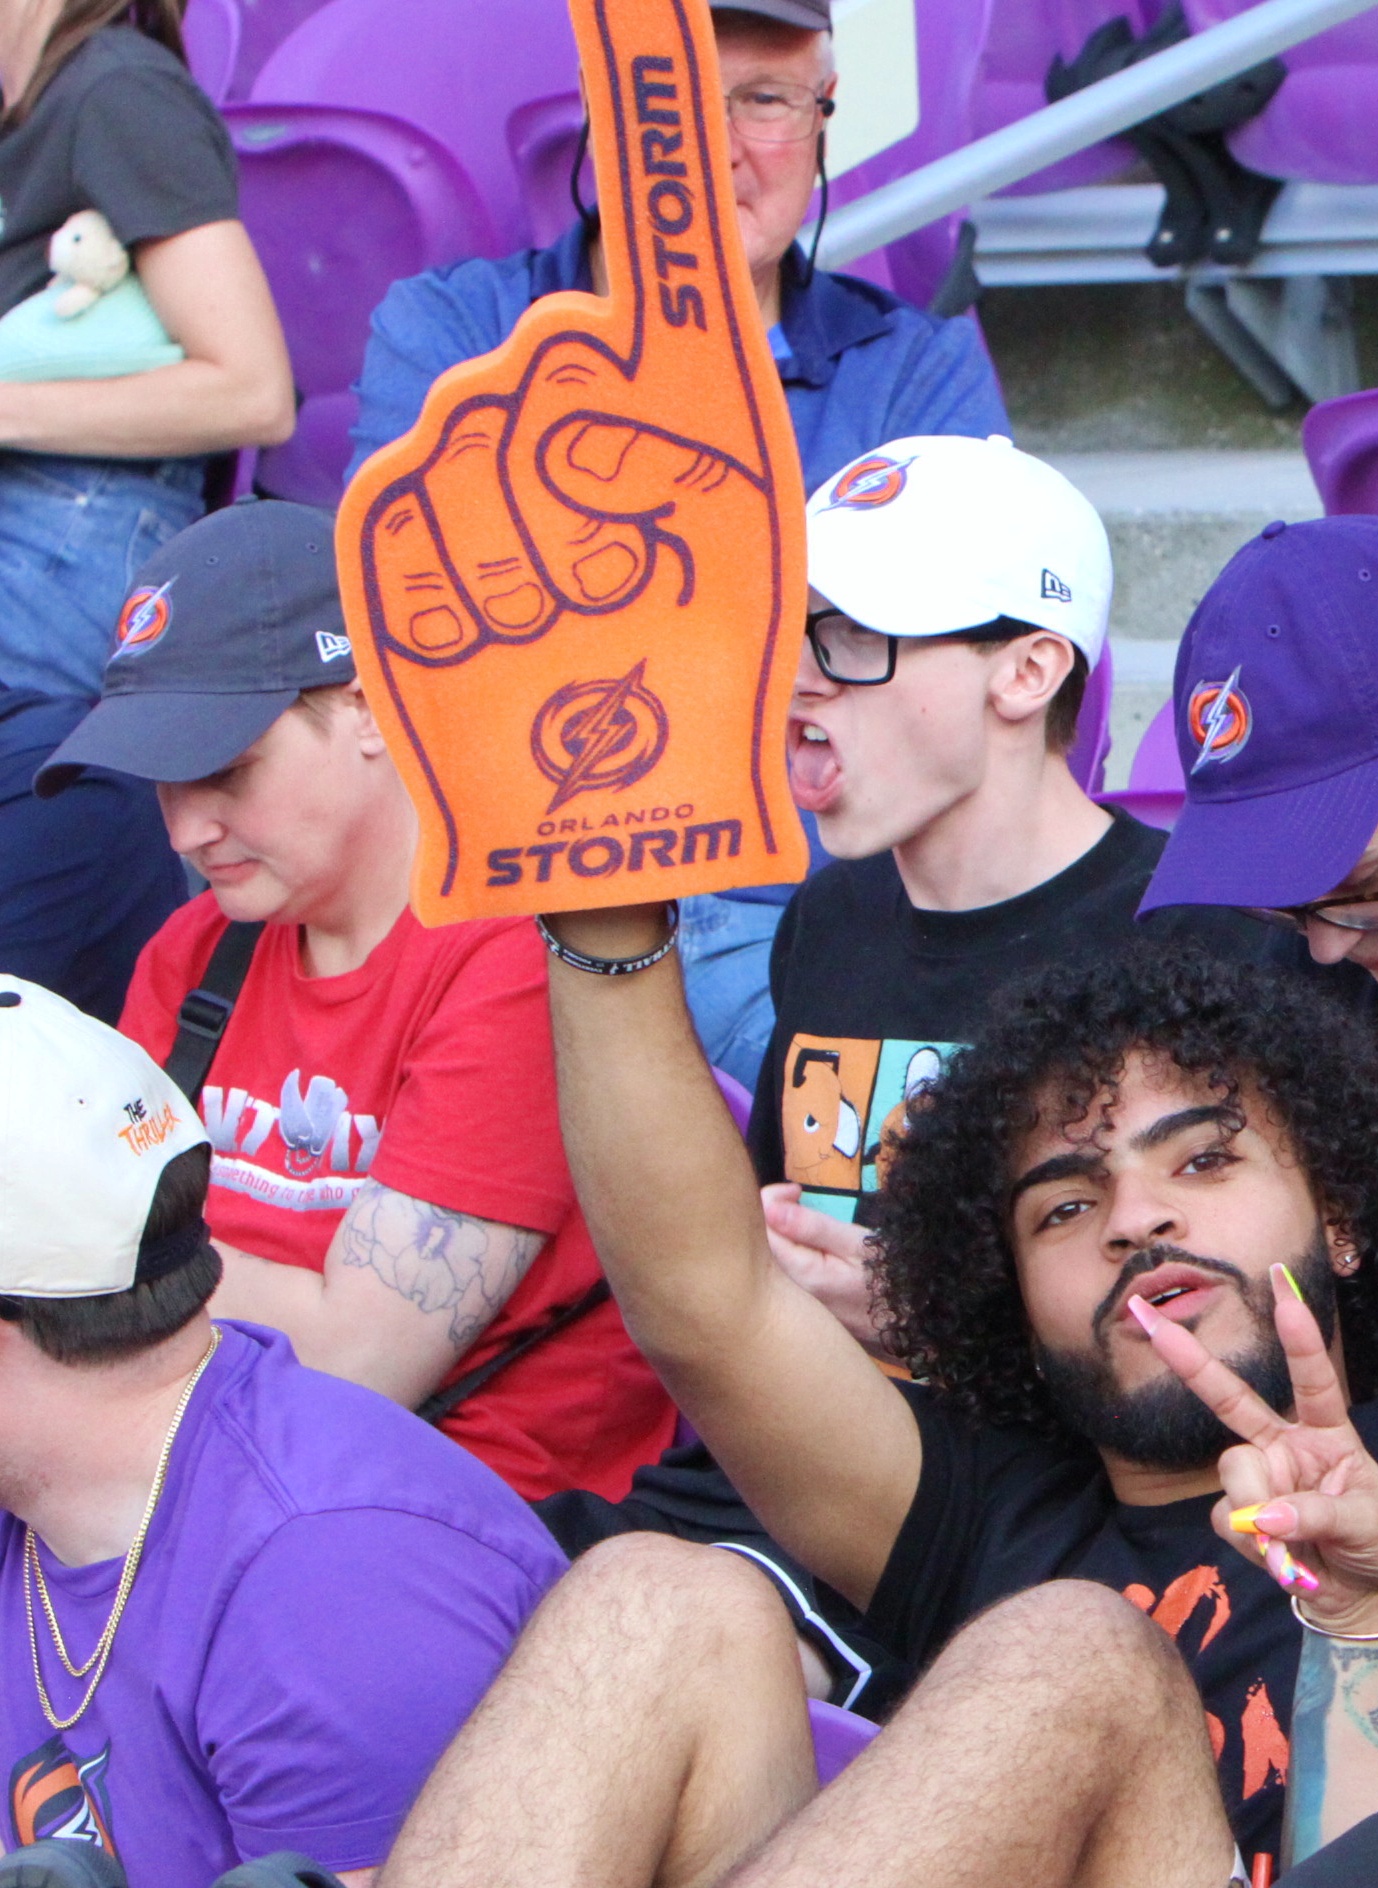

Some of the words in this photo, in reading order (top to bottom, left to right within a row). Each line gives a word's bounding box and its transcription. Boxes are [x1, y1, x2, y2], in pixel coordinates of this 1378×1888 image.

[631, 55, 708, 332] STORM
[537, 803, 695, 837] ORLANDO
[484, 818, 743, 887] STORM
[123, 1098, 147, 1125] THE
